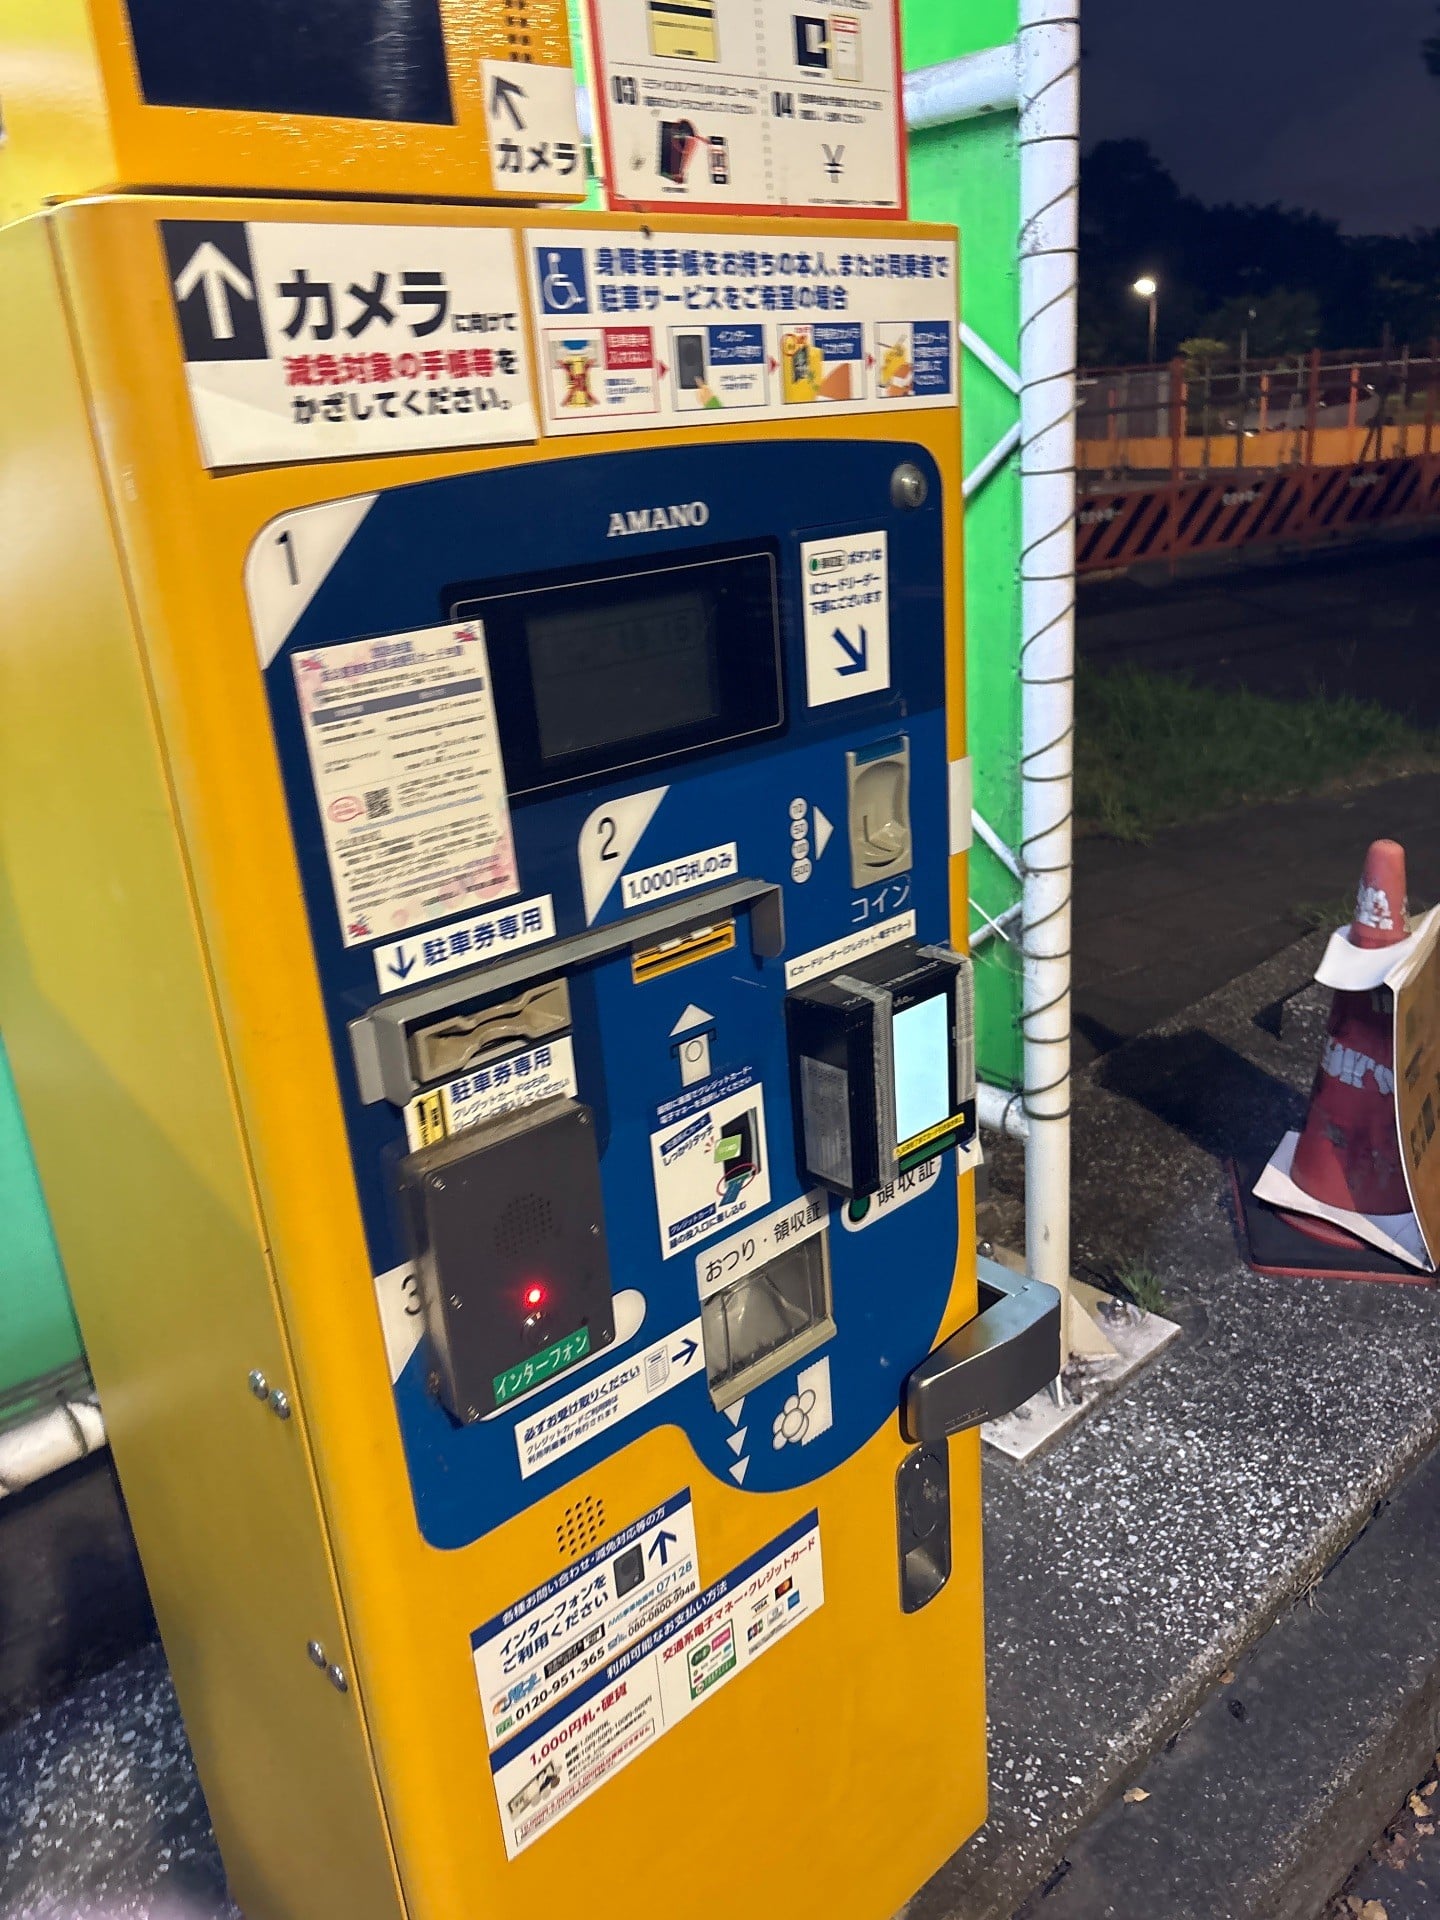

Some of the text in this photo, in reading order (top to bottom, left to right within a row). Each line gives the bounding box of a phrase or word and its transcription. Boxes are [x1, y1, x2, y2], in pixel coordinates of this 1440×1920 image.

[496, 138, 578, 175] カメラ
[279, 268, 450, 339] カメラ
[599, 284, 849, 315] 駐車サービスをご希望の場合
[291, 387, 513, 424] かざしてください。
[606, 501, 710, 538] AMANO
[276, 530, 300, 586] 1
[596, 817, 620, 861] 2
[627, 852, 734, 901] 1,000円札のみ
[851, 884, 910, 924] コイン
[421, 905, 543, 968] 駐車券専用
[449, 1046, 552, 1106] 駐車券専用
[704, 1201, 825, 1284] おつり・領収証
[400, 1273, 422, 1316] 3
[495, 1333, 589, 1399] インターフォン
[523, 1365, 642, 1445] 必ずお受け取りください
[655, 1560, 693, 1596] 07128
[662, 1535, 816, 1664] 交通系電子マネー・クレジットカード
[500, 1572, 607, 1657] インターフォンを
[502, 1591, 609, 1675] ご利用ください
[605, 1578, 728, 1680] 利用可能なお支払い方法
[515, 1646, 606, 1721] 0120-951-365
[528, 1680, 628, 1767] 1,000円札・硬貨
